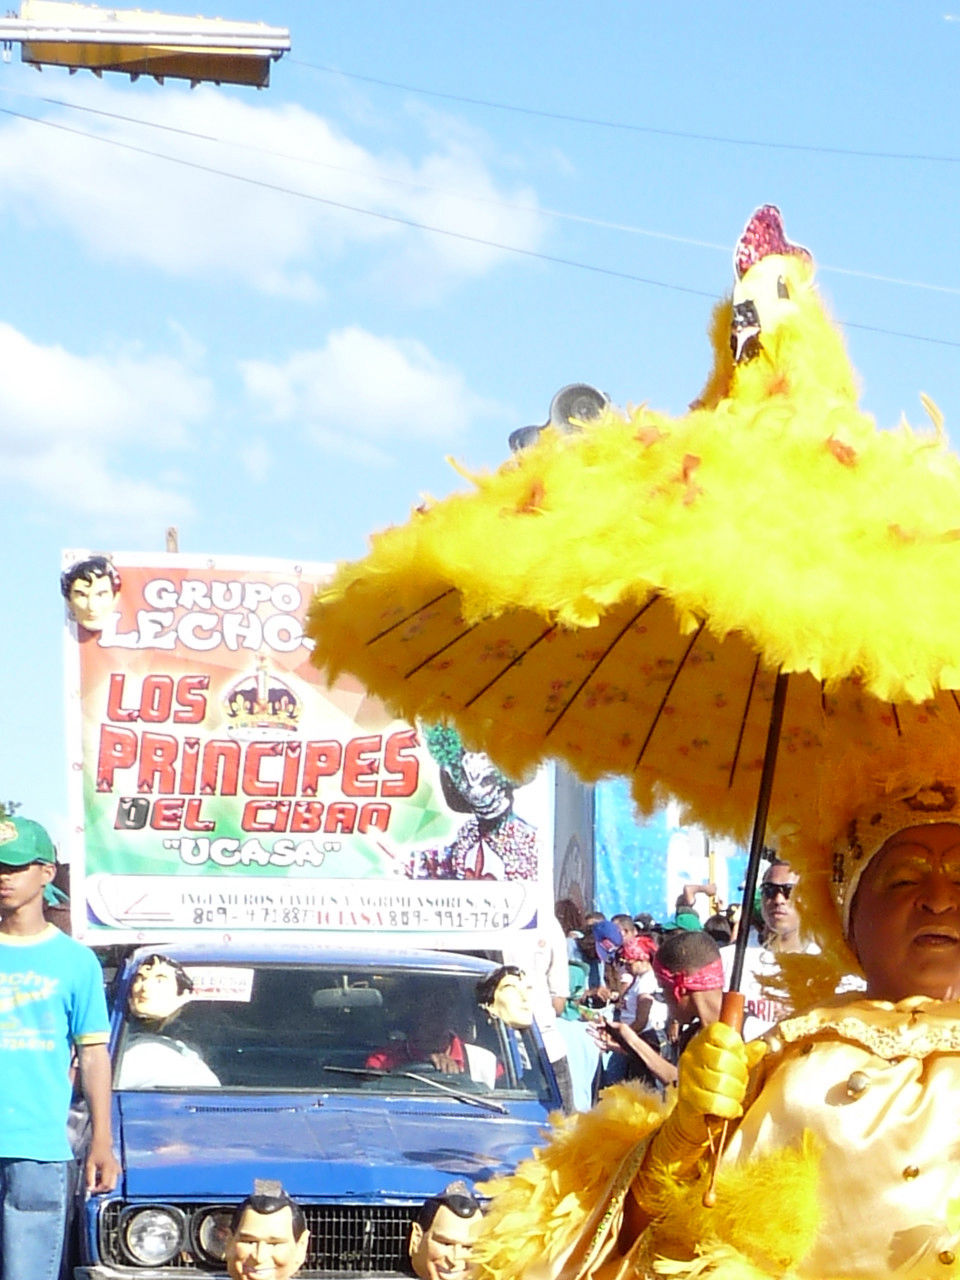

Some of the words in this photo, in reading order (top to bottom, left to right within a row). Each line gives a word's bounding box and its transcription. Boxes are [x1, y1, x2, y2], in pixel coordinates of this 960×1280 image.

[143, 578, 302, 612] GRUPO
[97, 608, 317, 653] LECHO
[106, 673, 210, 724] LOS
[114, 796, 216, 832] DEL
[241, 800, 392, 834] CIBAO
[163, 837, 342, 867] "UCASA"
